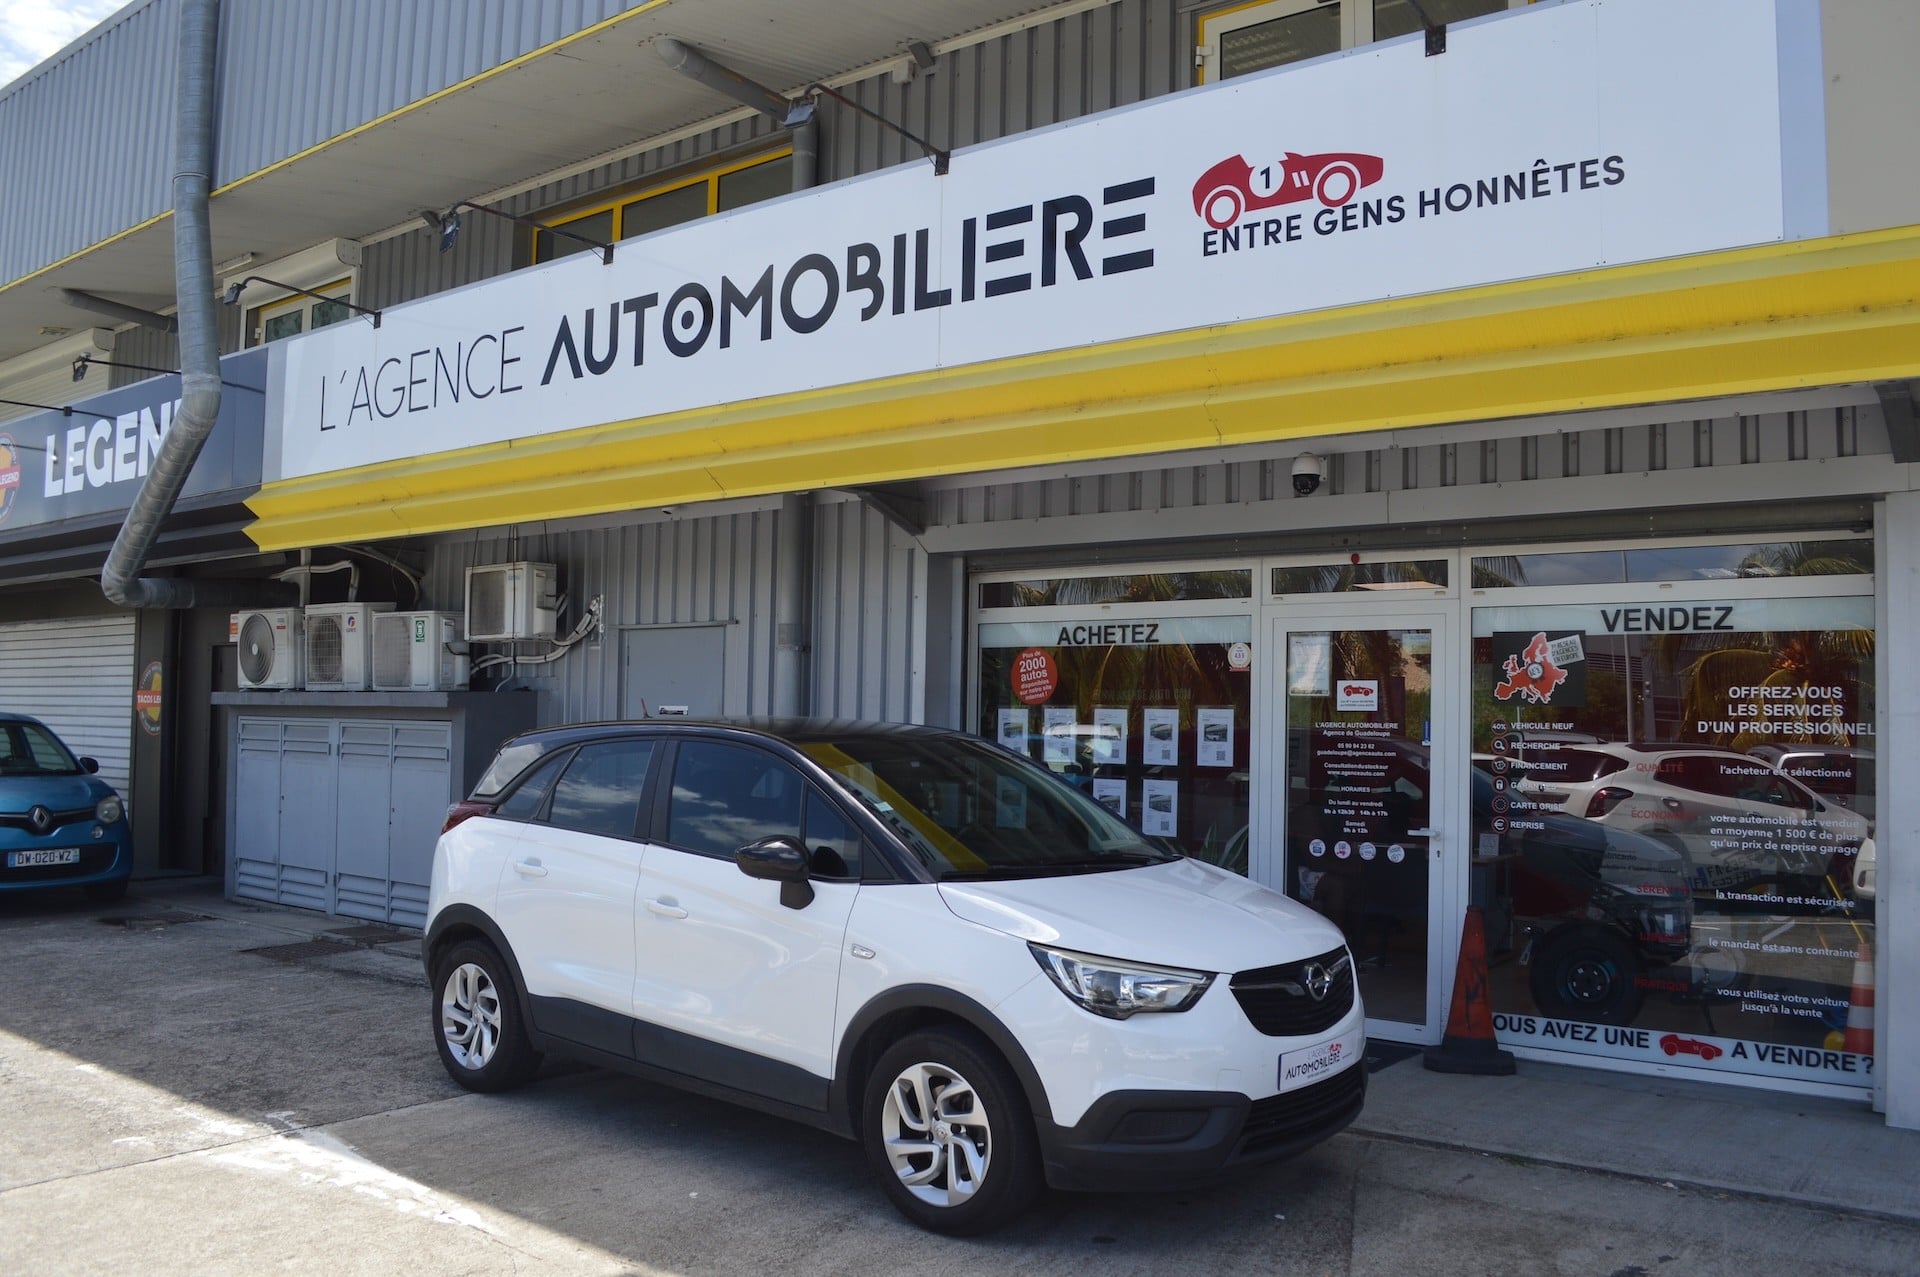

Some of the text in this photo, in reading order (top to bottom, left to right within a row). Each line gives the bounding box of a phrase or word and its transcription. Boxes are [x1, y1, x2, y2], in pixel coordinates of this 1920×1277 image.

[1259, 166, 1270, 190] 1
[1202, 155, 1625, 257] ENTRE GENS HONNÊTES
[320, 176, 1155, 431] L'AGENCE AUTOMOBILIERE
[1600, 606, 1735, 632] VENDEZ
[1057, 623, 1160, 646] ACHETEZ
[1019, 656, 1047, 673] 2000
[1021, 669, 1048, 683] autos
[1728, 686, 1843, 699] OFFREZ-VOUS
[1728, 704, 1844, 717] LES SERVICES
[1315, 721, 1399, 730] L'AGENCE AUTOMOBILIERE
[1554, 722, 1574, 730] NEUF
[1697, 721, 1876, 735] D'UN PROFESSIONNEL
[1323, 729, 1345, 737] Agence
[1354, 730, 1391, 738] Guadeloupe
[1510, 742, 1560, 750] RECHERCHE
[1510, 762, 1569, 770] FINANCEMENT
[1720, 764, 1771, 776] l'acheteur
[1773, 767, 1790, 776] est
[1791, 765, 1852, 778] sélectionné
[1510, 781, 1557, 790] GARANIES
[1510, 801, 1537, 810] CARTE
[1510, 821, 1545, 830] REPRISE
[1710, 815, 1860, 828] votre automobile est vendue
[1710, 827, 1723, 836] en
[1726, 828, 1774, 839] moyenne
[1819, 831, 1833, 841] de
[1835, 832, 1859, 842] plus
[1710, 838, 1859, 856] qu'un prix de reprise garage
[1715, 889, 1724, 899] la
[1727, 890, 1784, 903] transaction
[1786, 895, 1803, 905] est
[1804, 894, 1855, 908] sécurisée
[1708, 936, 1861, 959] le mandat est sans contrainte
[1717, 988, 1742, 998] vous
[1743, 988, 1780, 1001] utilisez
[1781, 992, 1809, 1004] votre
[1811, 994, 1850, 1008] voiture
[1740, 1000, 1824, 1018] jusqu'à la vente
[1493, 1014, 1537, 1035] OUS
[1541, 1021, 1598, 1043] AVEZ
[1604, 1027, 1650, 1049] UNE
[1731, 1041, 1748, 1060] A
[1754, 1043, 1857, 1073] VENDRE
